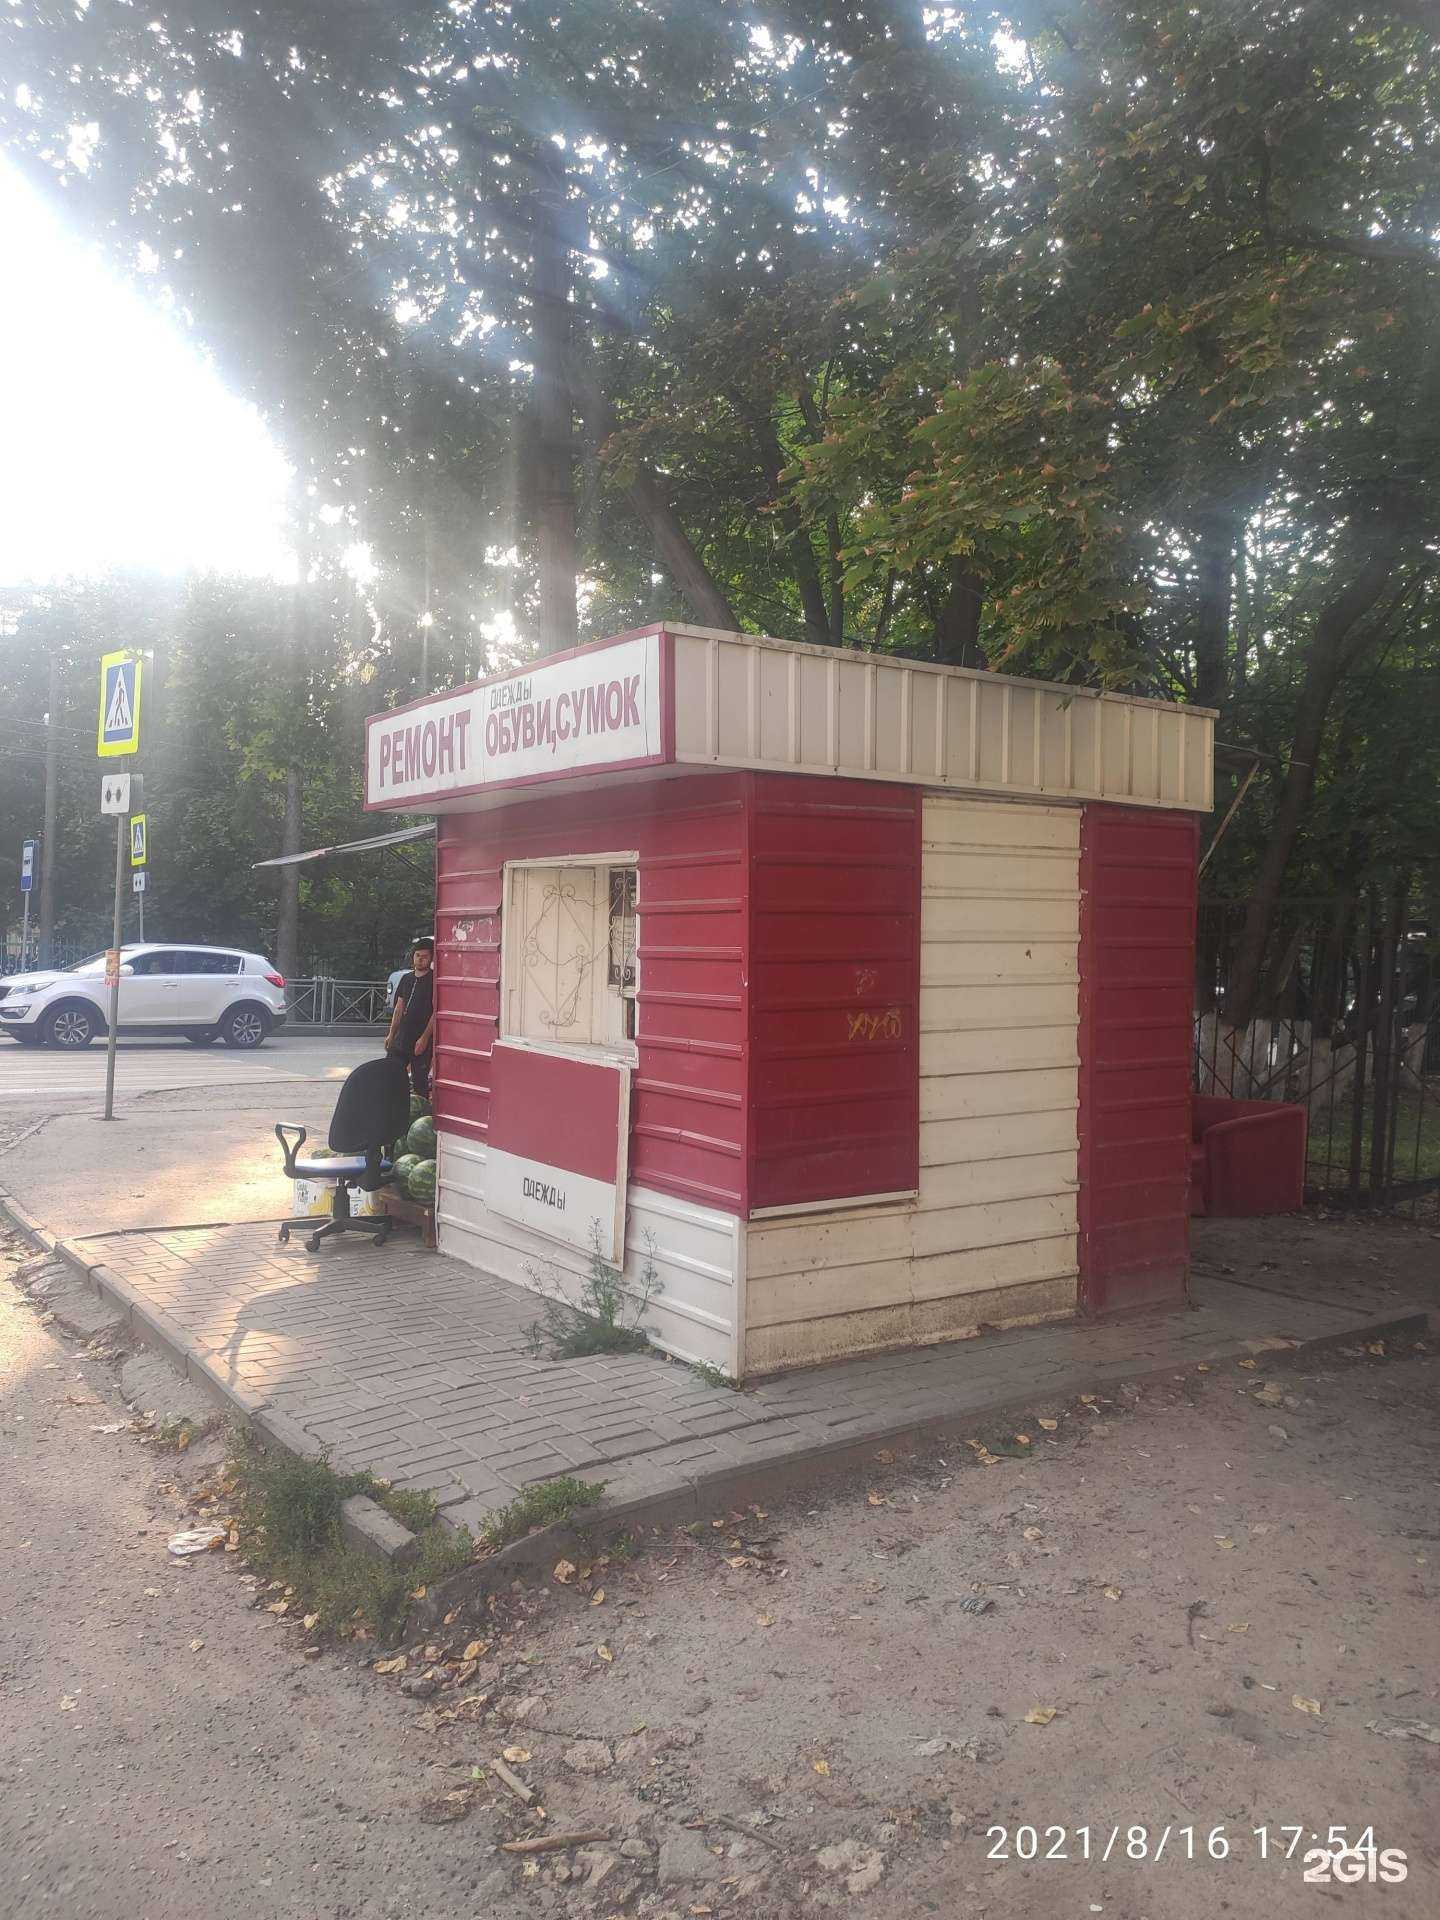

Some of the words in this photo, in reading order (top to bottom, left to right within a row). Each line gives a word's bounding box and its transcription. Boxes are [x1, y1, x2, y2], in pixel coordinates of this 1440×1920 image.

[490, 678, 532, 710] ОДЕЖДЫ
[379, 708, 471, 788] РЕМОНТ
[523, 1177, 566, 1211] ОДЕЖДЫ
